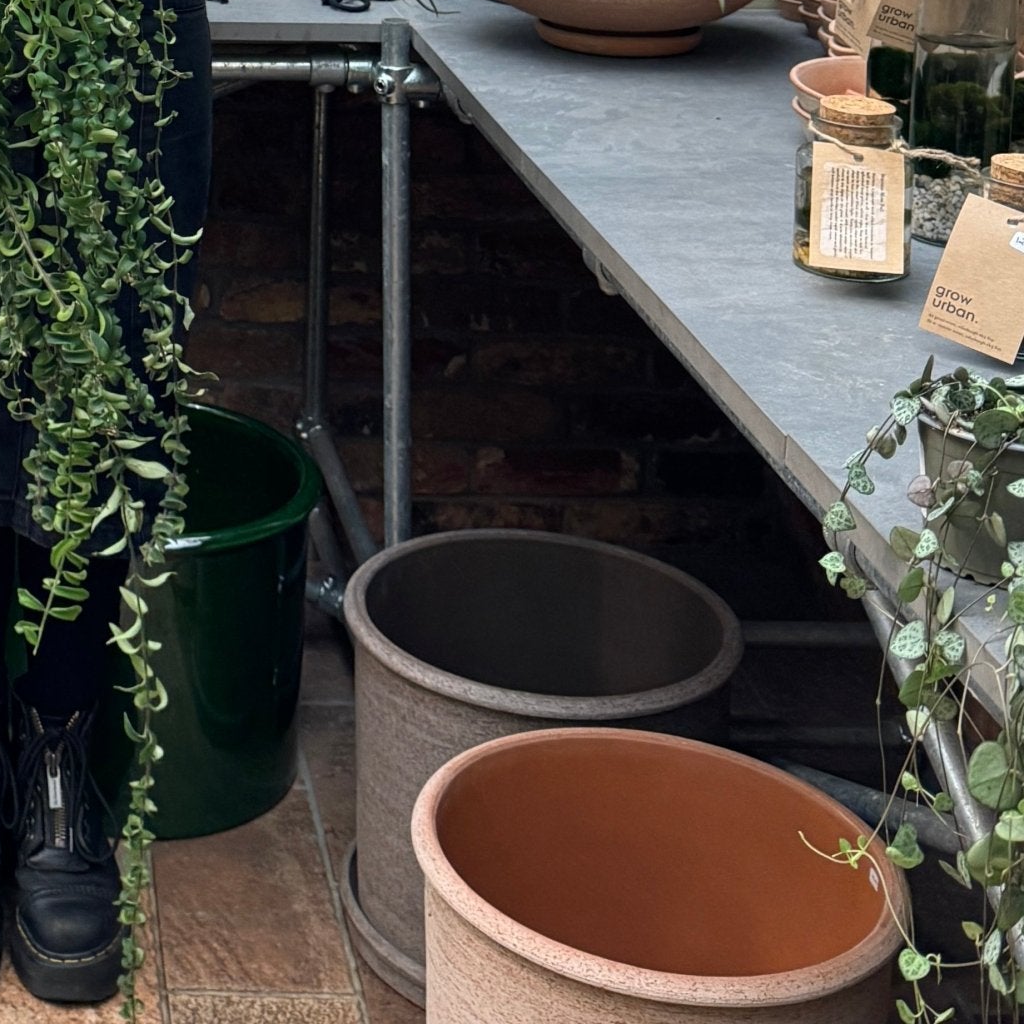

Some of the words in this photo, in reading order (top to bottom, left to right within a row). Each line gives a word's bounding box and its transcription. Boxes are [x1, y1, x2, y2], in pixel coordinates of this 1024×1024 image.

[882, 4, 913, 19] grow
[935, 285, 972, 306] grow
[932, 298, 979, 324] urban.
